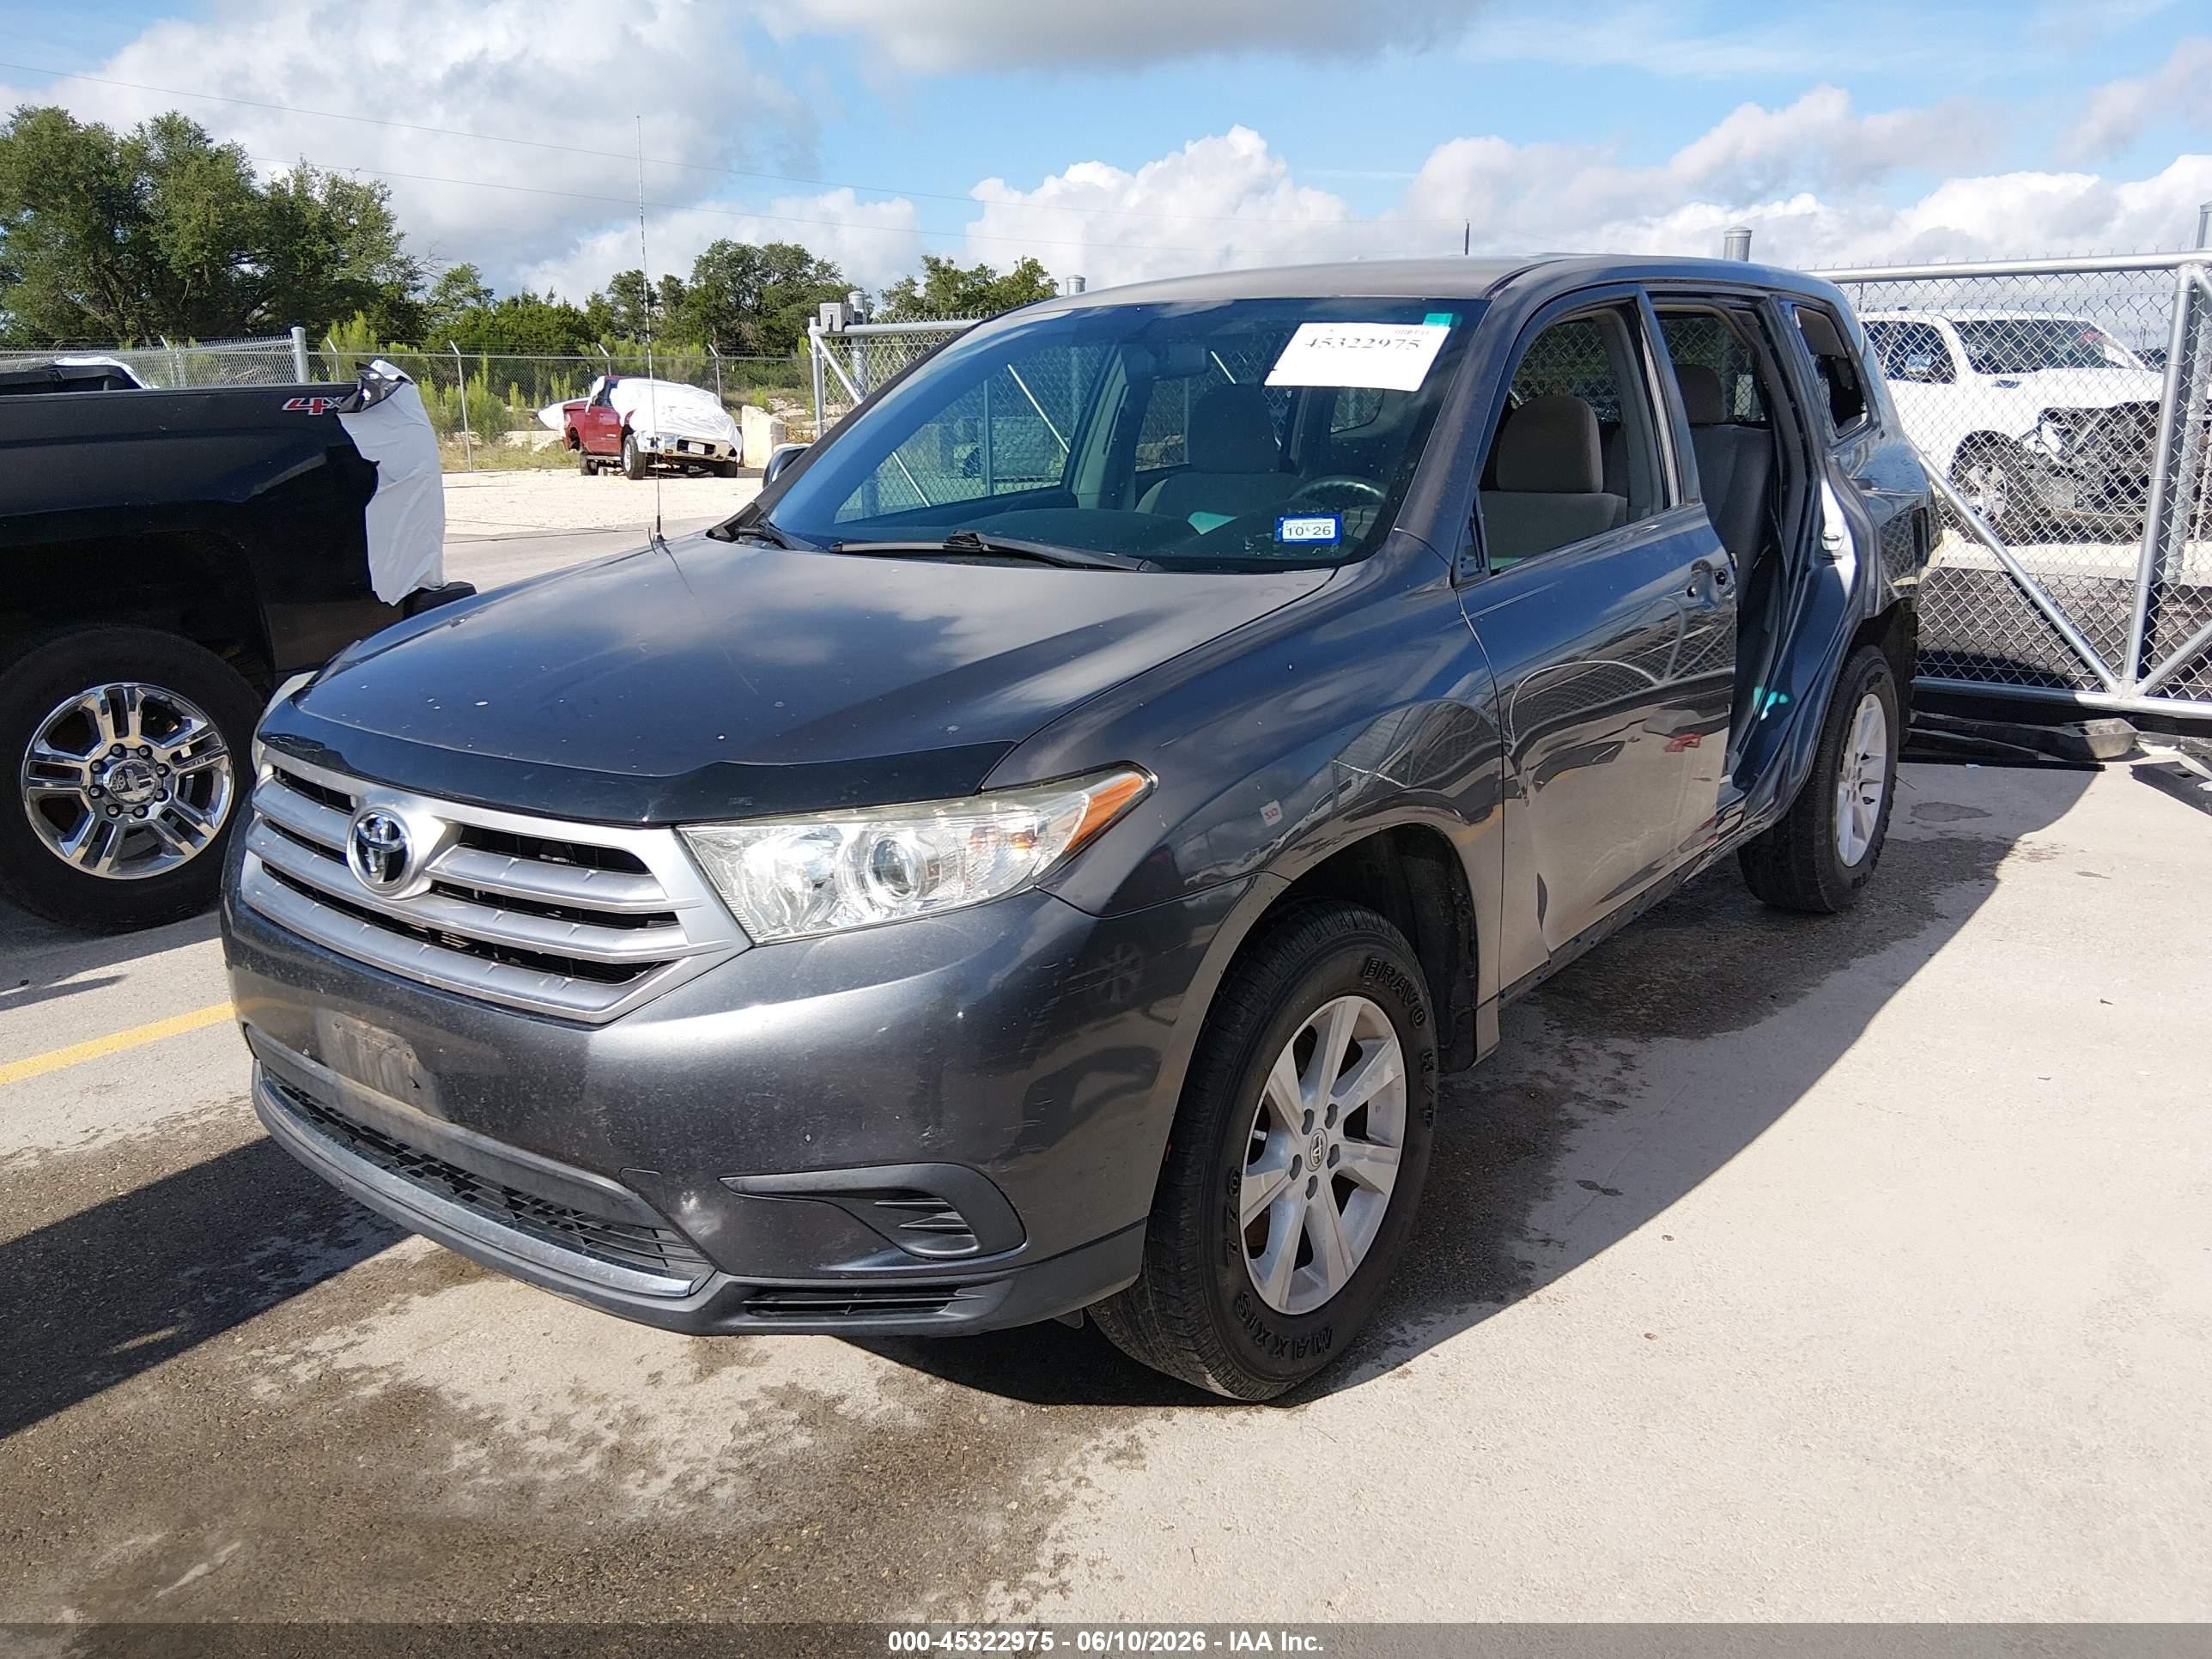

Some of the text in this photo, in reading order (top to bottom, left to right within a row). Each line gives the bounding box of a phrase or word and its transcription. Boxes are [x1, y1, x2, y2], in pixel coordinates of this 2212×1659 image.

[1304, 337, 1423, 350] 45322975
[282, 397, 344, 416] 4X
[1285, 526, 1331, 536] 10 26
[1363, 957, 1426, 1029] BRAVO
[1237, 1291, 1334, 1361] MAXXIS
